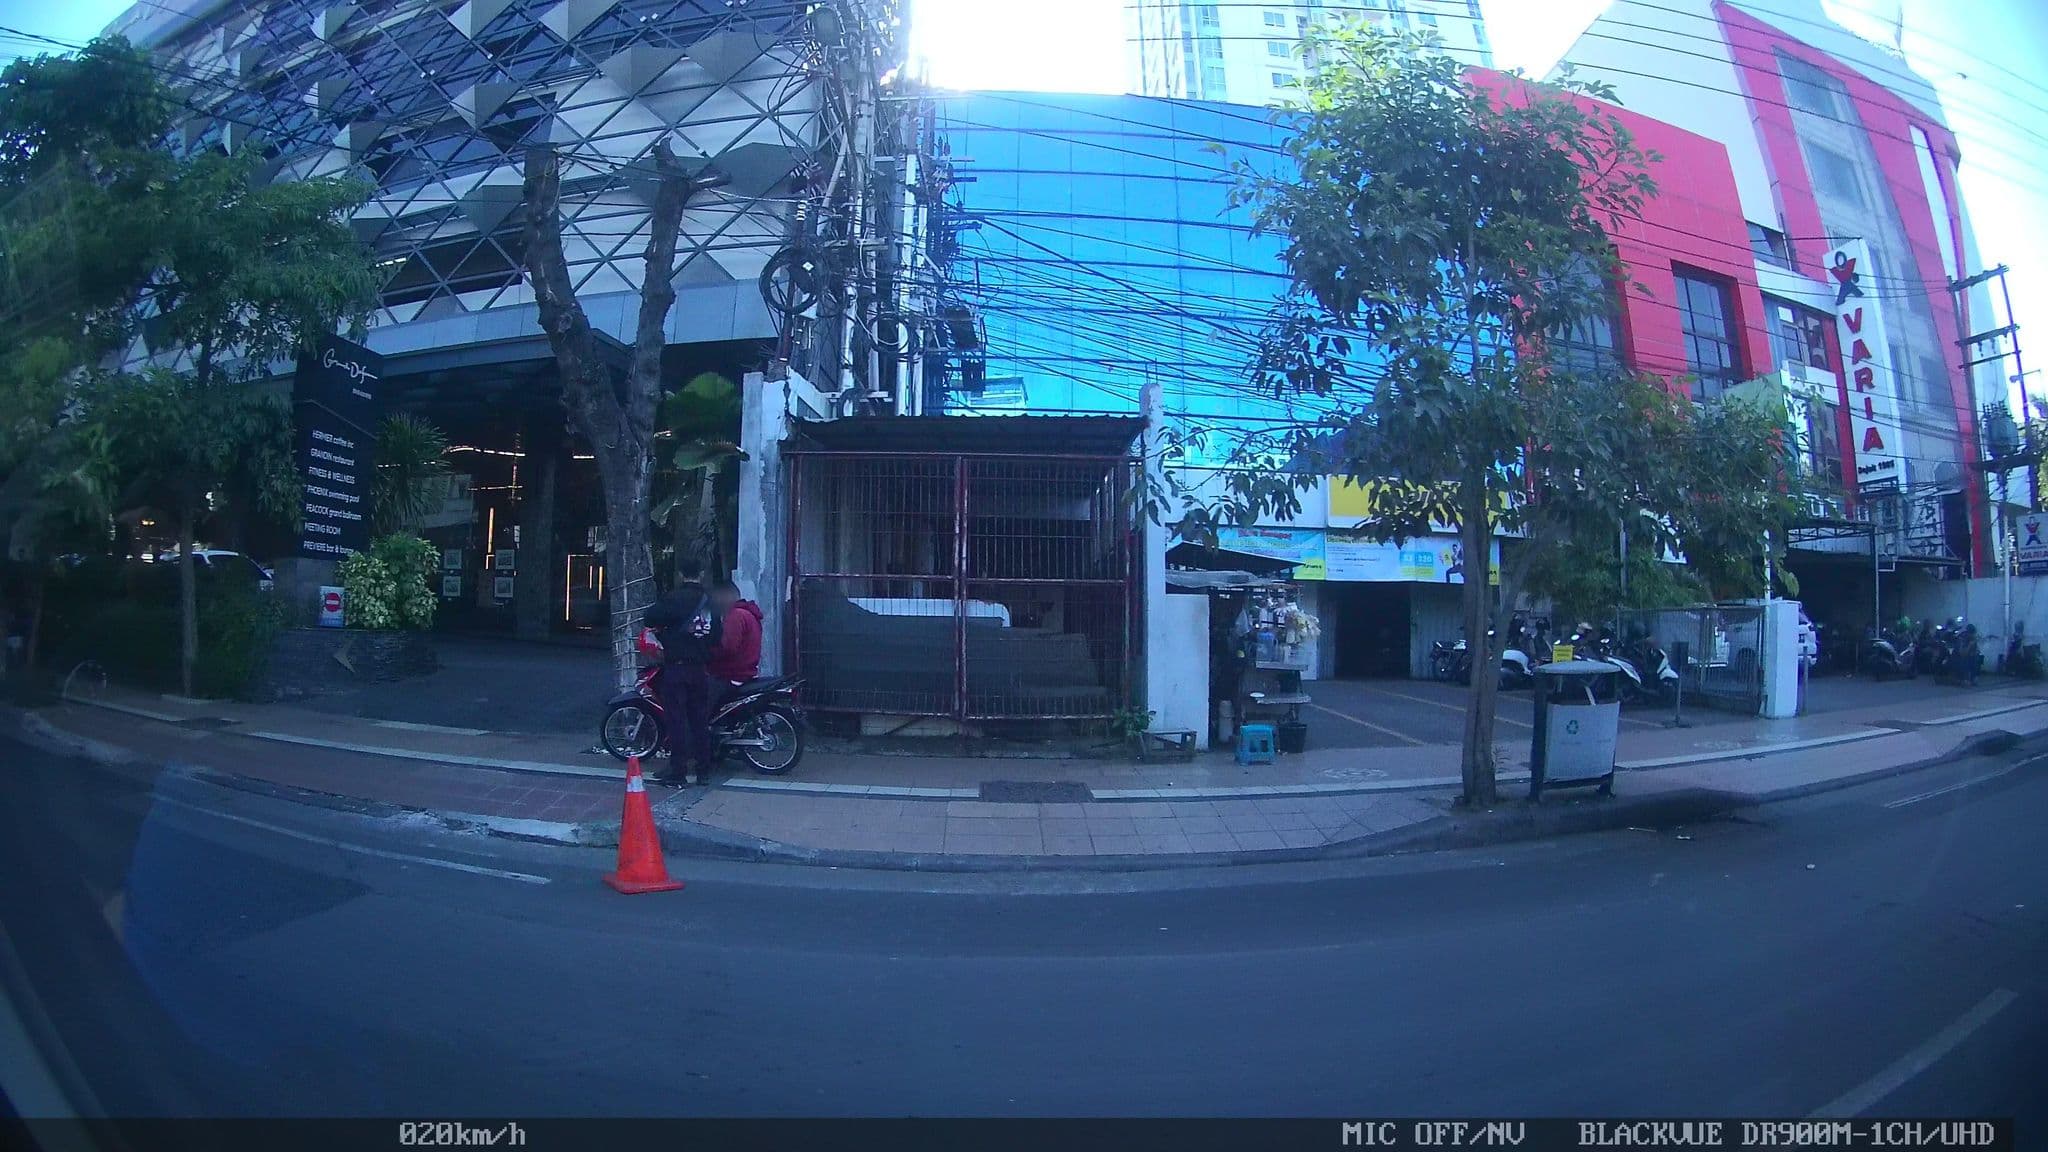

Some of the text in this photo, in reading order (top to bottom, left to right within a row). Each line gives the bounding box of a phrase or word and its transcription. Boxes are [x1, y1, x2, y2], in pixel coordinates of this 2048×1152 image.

[1843, 307, 1885, 452] VARIA
[308, 466, 328, 478] FITNESS
[332, 472, 355, 485] WELLNESS
[307, 484, 329, 497] PHOENIX
[305, 503, 329, 515] PEACOCK
[304, 522, 341, 536] MEETING ROOM
